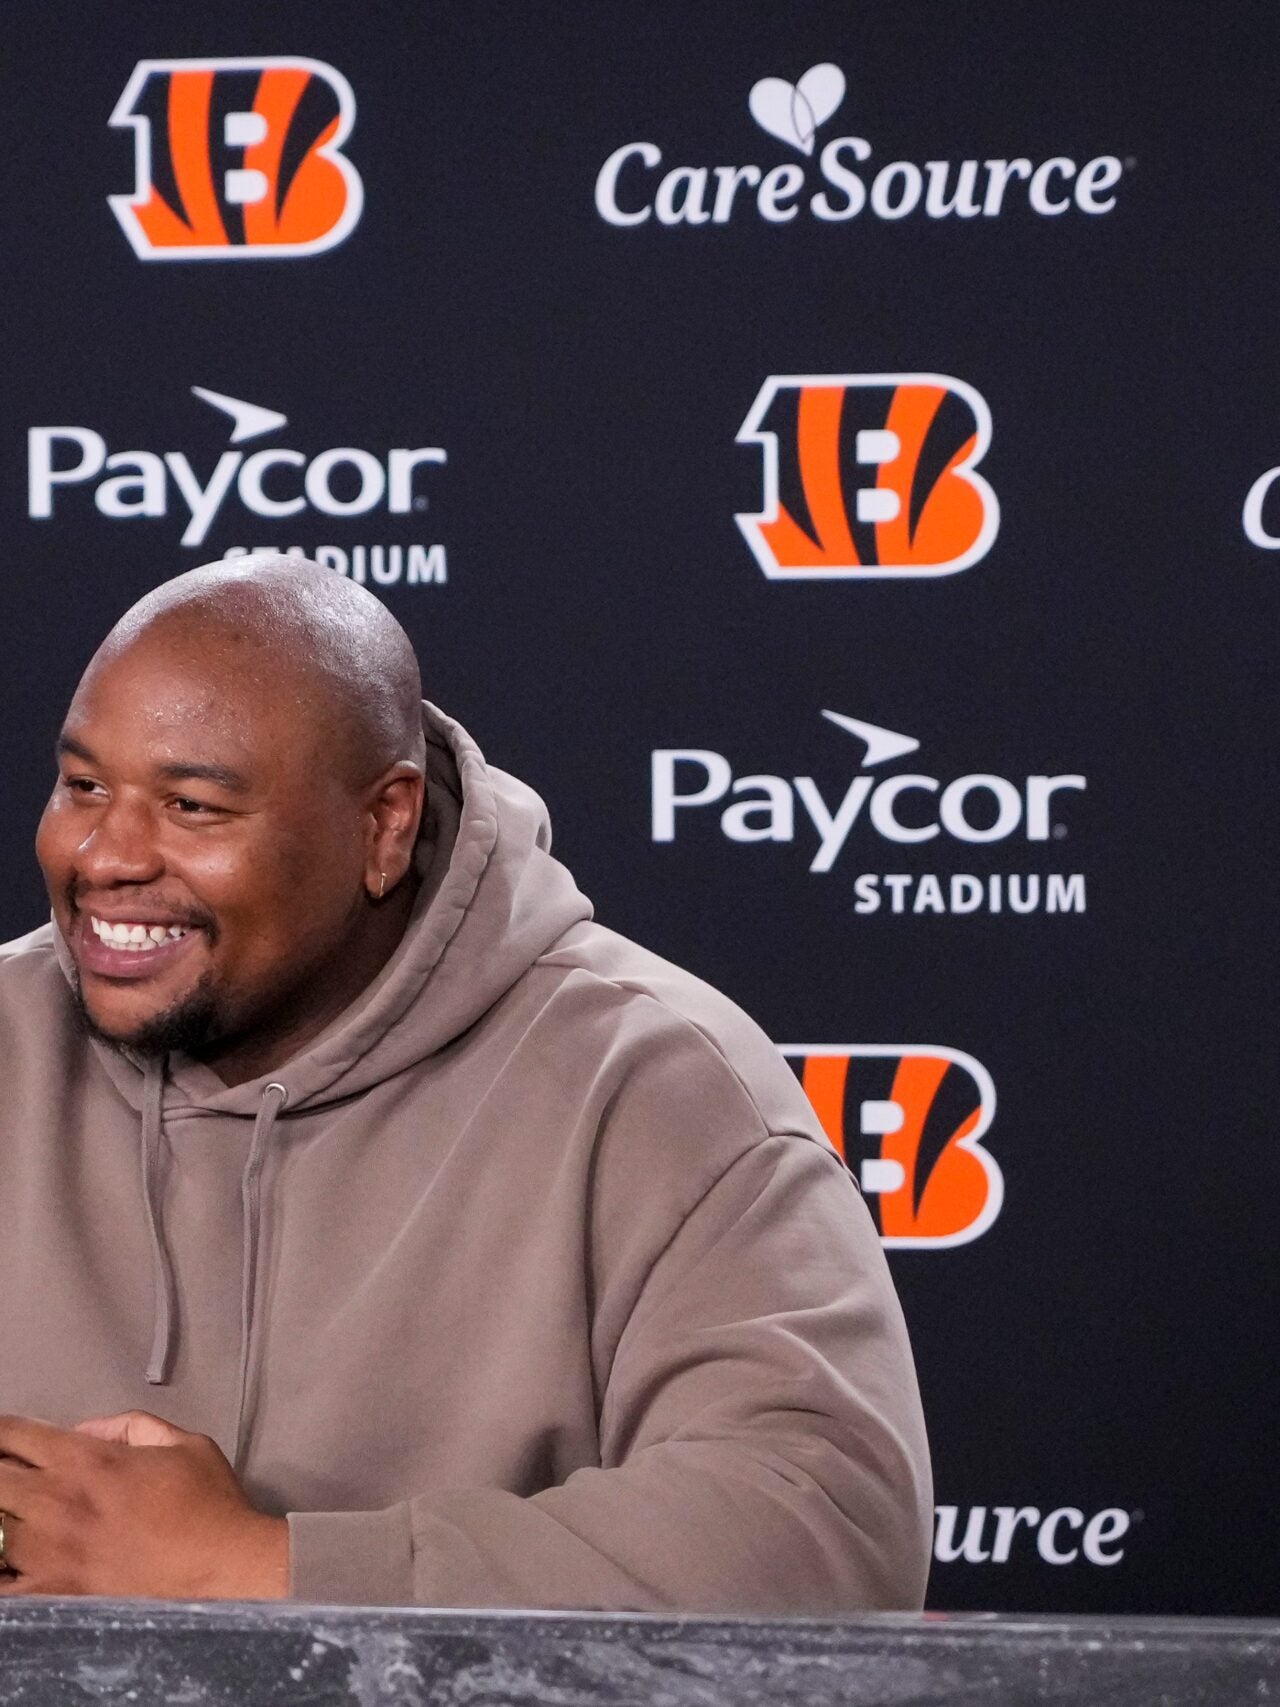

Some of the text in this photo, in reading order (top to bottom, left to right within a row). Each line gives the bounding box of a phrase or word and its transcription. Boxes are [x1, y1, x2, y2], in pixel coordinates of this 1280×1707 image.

[107, 56, 364, 262] B
[594, 136, 1122, 228] CareSource
[27, 425, 448, 548] Paycor
[734, 372, 1000, 580] B
[222, 544, 448, 584] DIUM
[651, 748, 1088, 874] Paycor
[854, 873, 1087, 914] STADIUM
